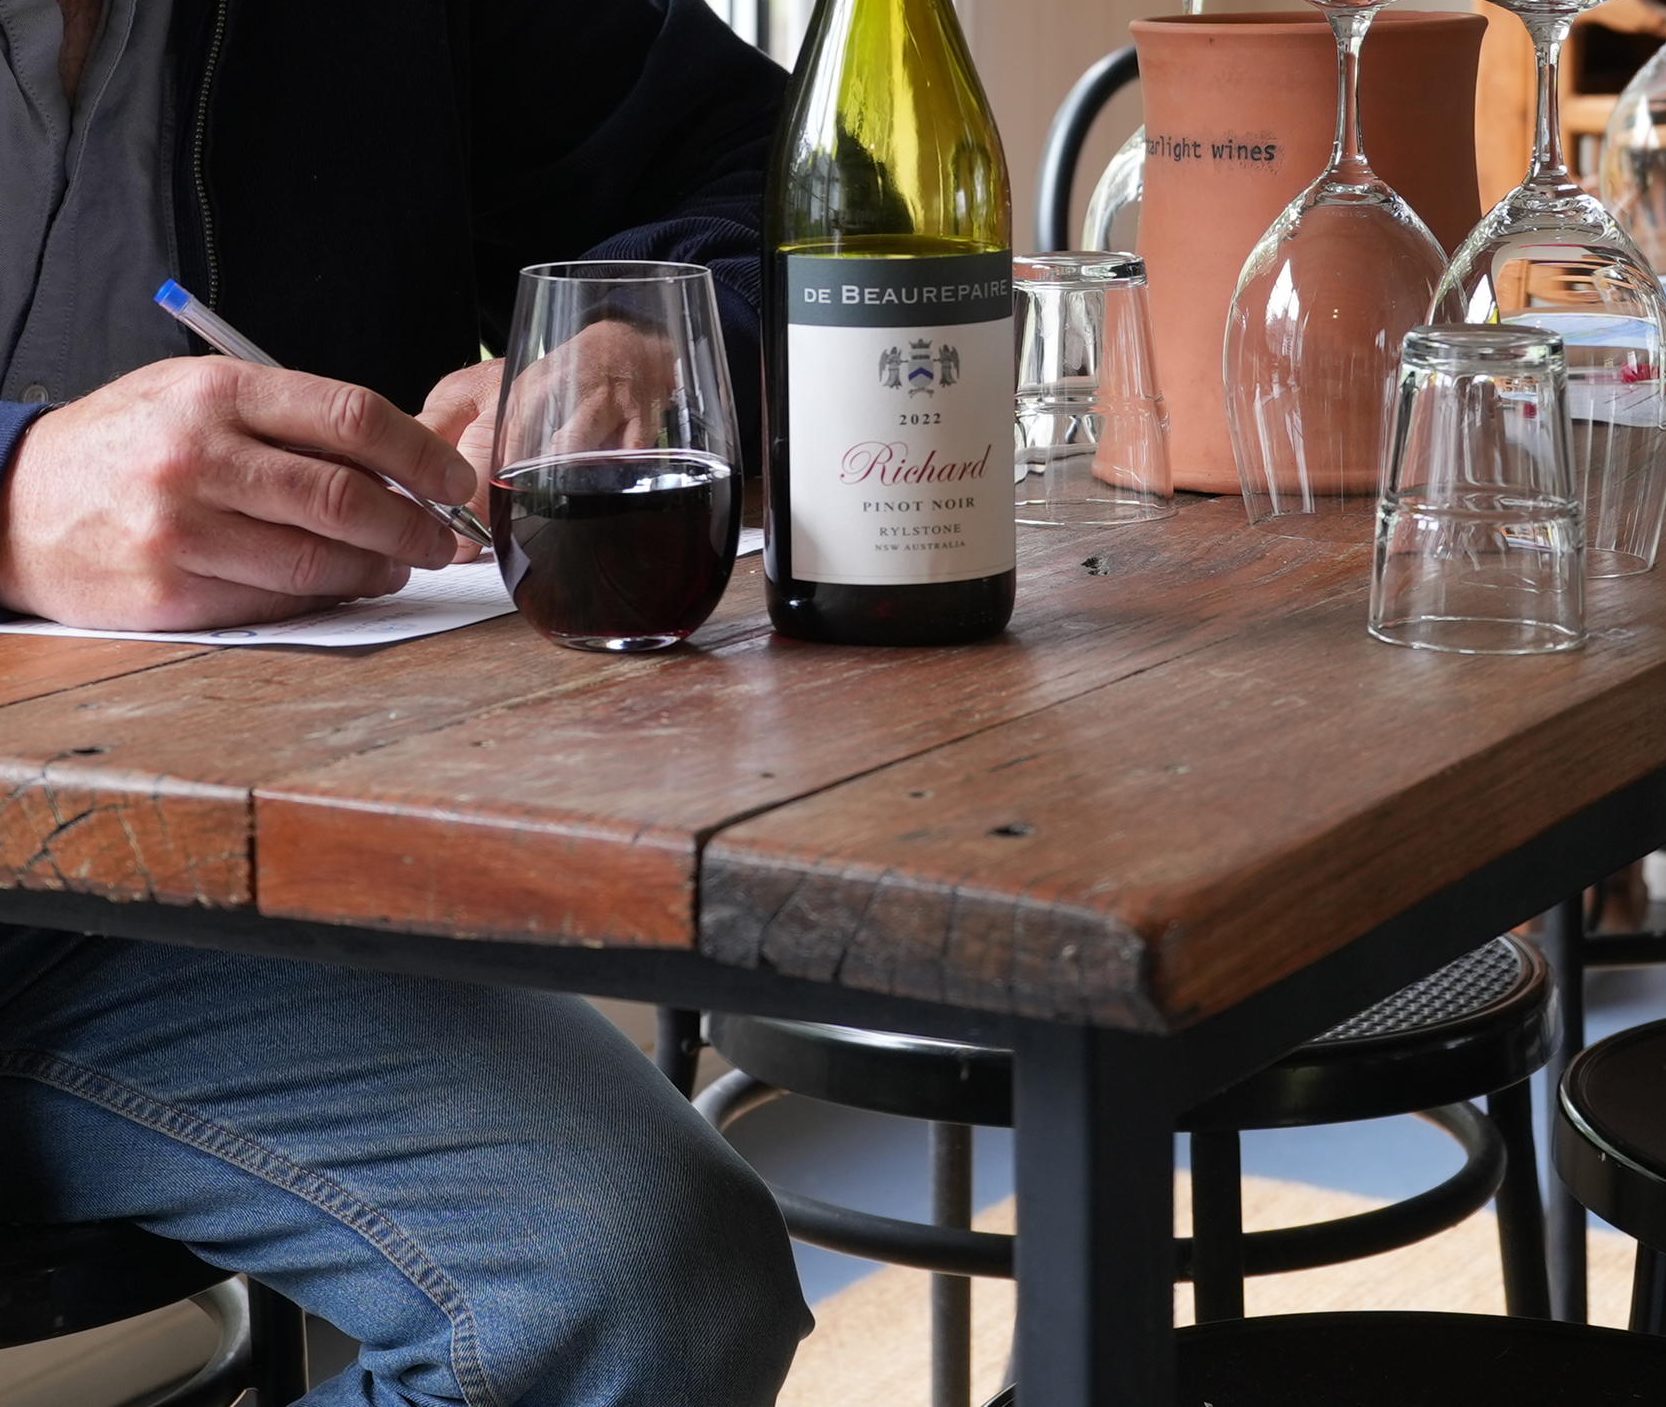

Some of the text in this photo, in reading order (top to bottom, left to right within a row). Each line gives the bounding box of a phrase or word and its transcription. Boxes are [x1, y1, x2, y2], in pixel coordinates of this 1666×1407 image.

[1211, 139, 1277, 162] wines
[803, 278, 1009, 306] DE BEAUREPAIRE
[898, 412, 942, 426] 2022
[838, 440, 993, 486] Richard
[861, 496, 976, 513] PINOT NOIR
[878, 522, 963, 538] RYLSTONE
[874, 539, 967, 553] NSW AUSTRALIA
